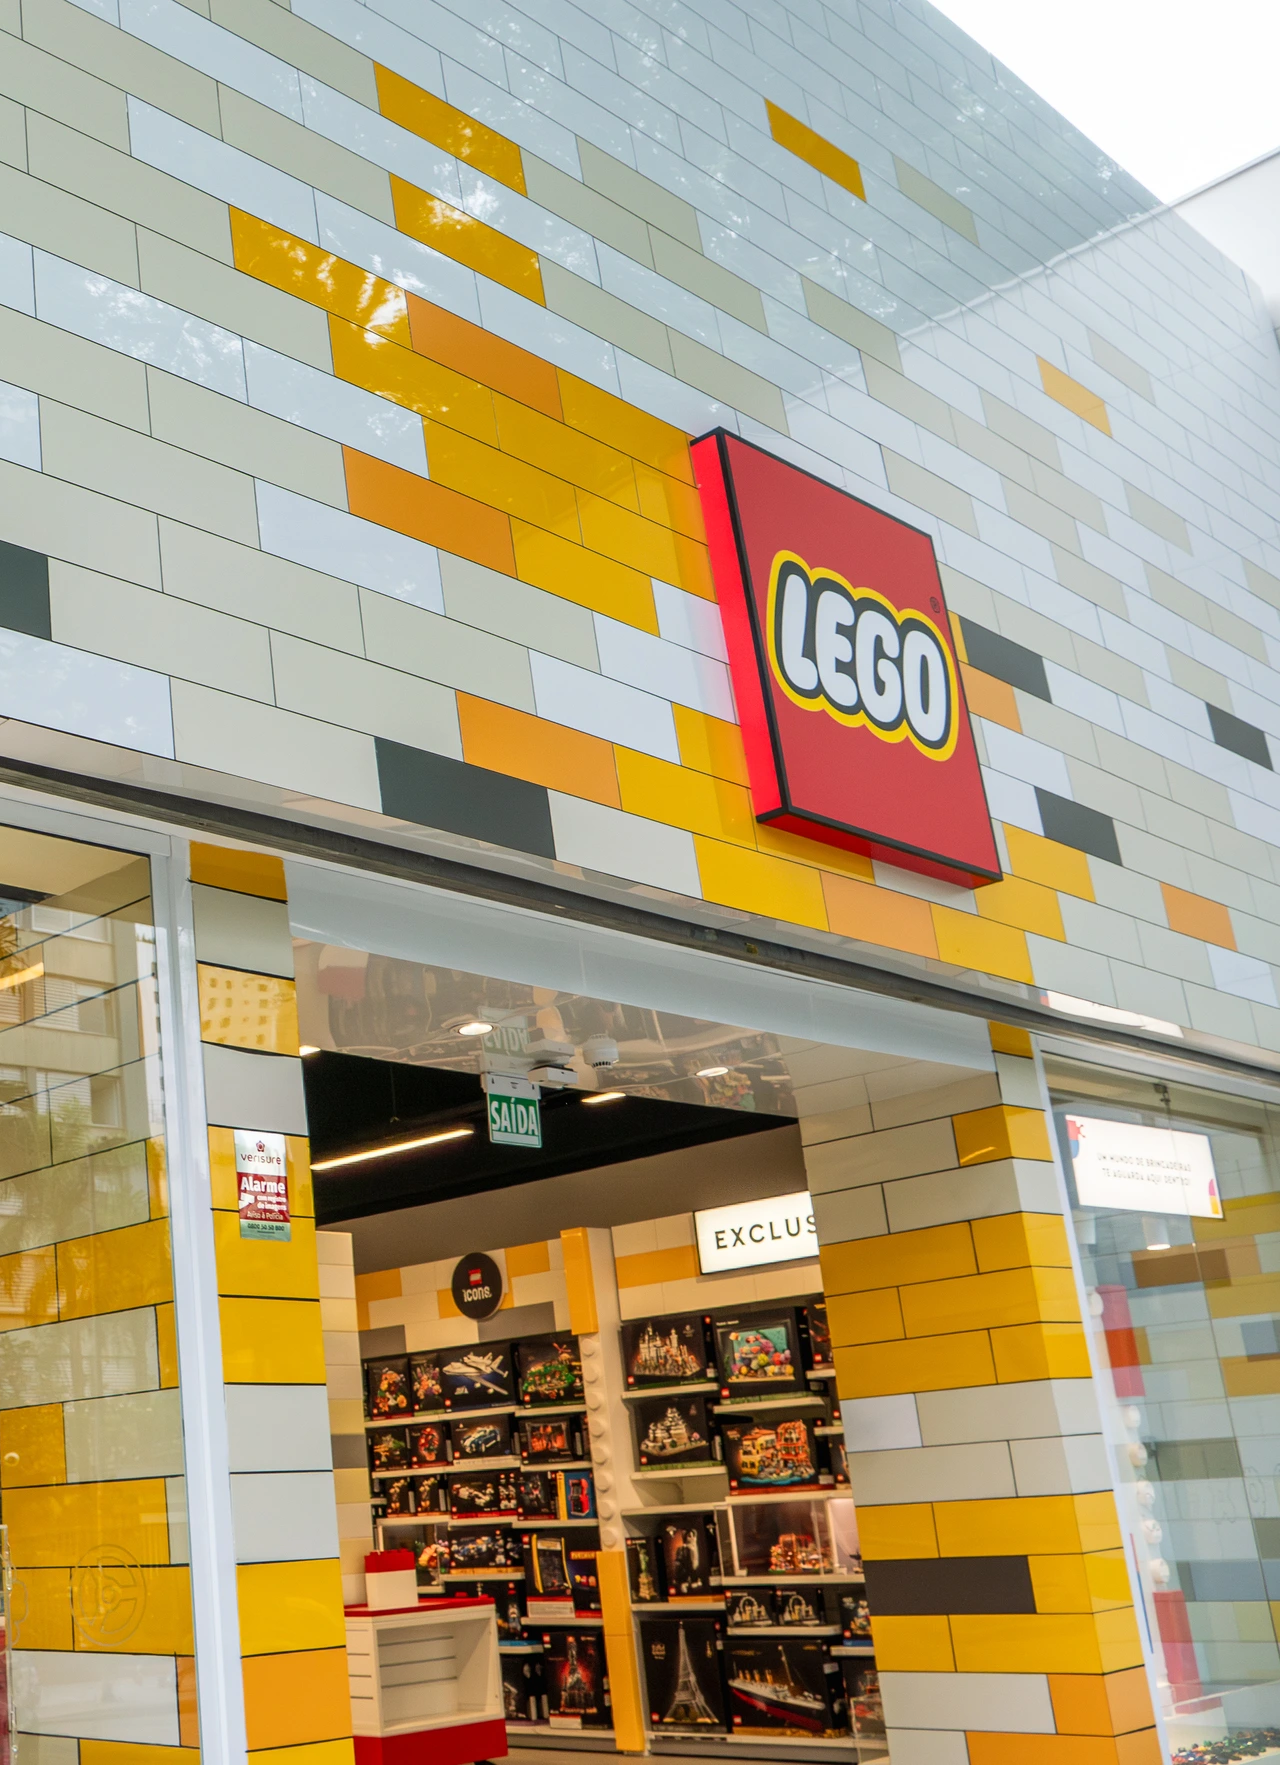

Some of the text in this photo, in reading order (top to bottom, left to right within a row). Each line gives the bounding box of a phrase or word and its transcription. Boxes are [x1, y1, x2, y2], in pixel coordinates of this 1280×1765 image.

[774, 560, 953, 751] LEGO
[490, 1097, 539, 1136] SAÍDA
[240, 1153, 282, 1165] verisure
[240, 1175, 286, 1194] Alarme
[714, 1215, 817, 1250] EXCLUS
